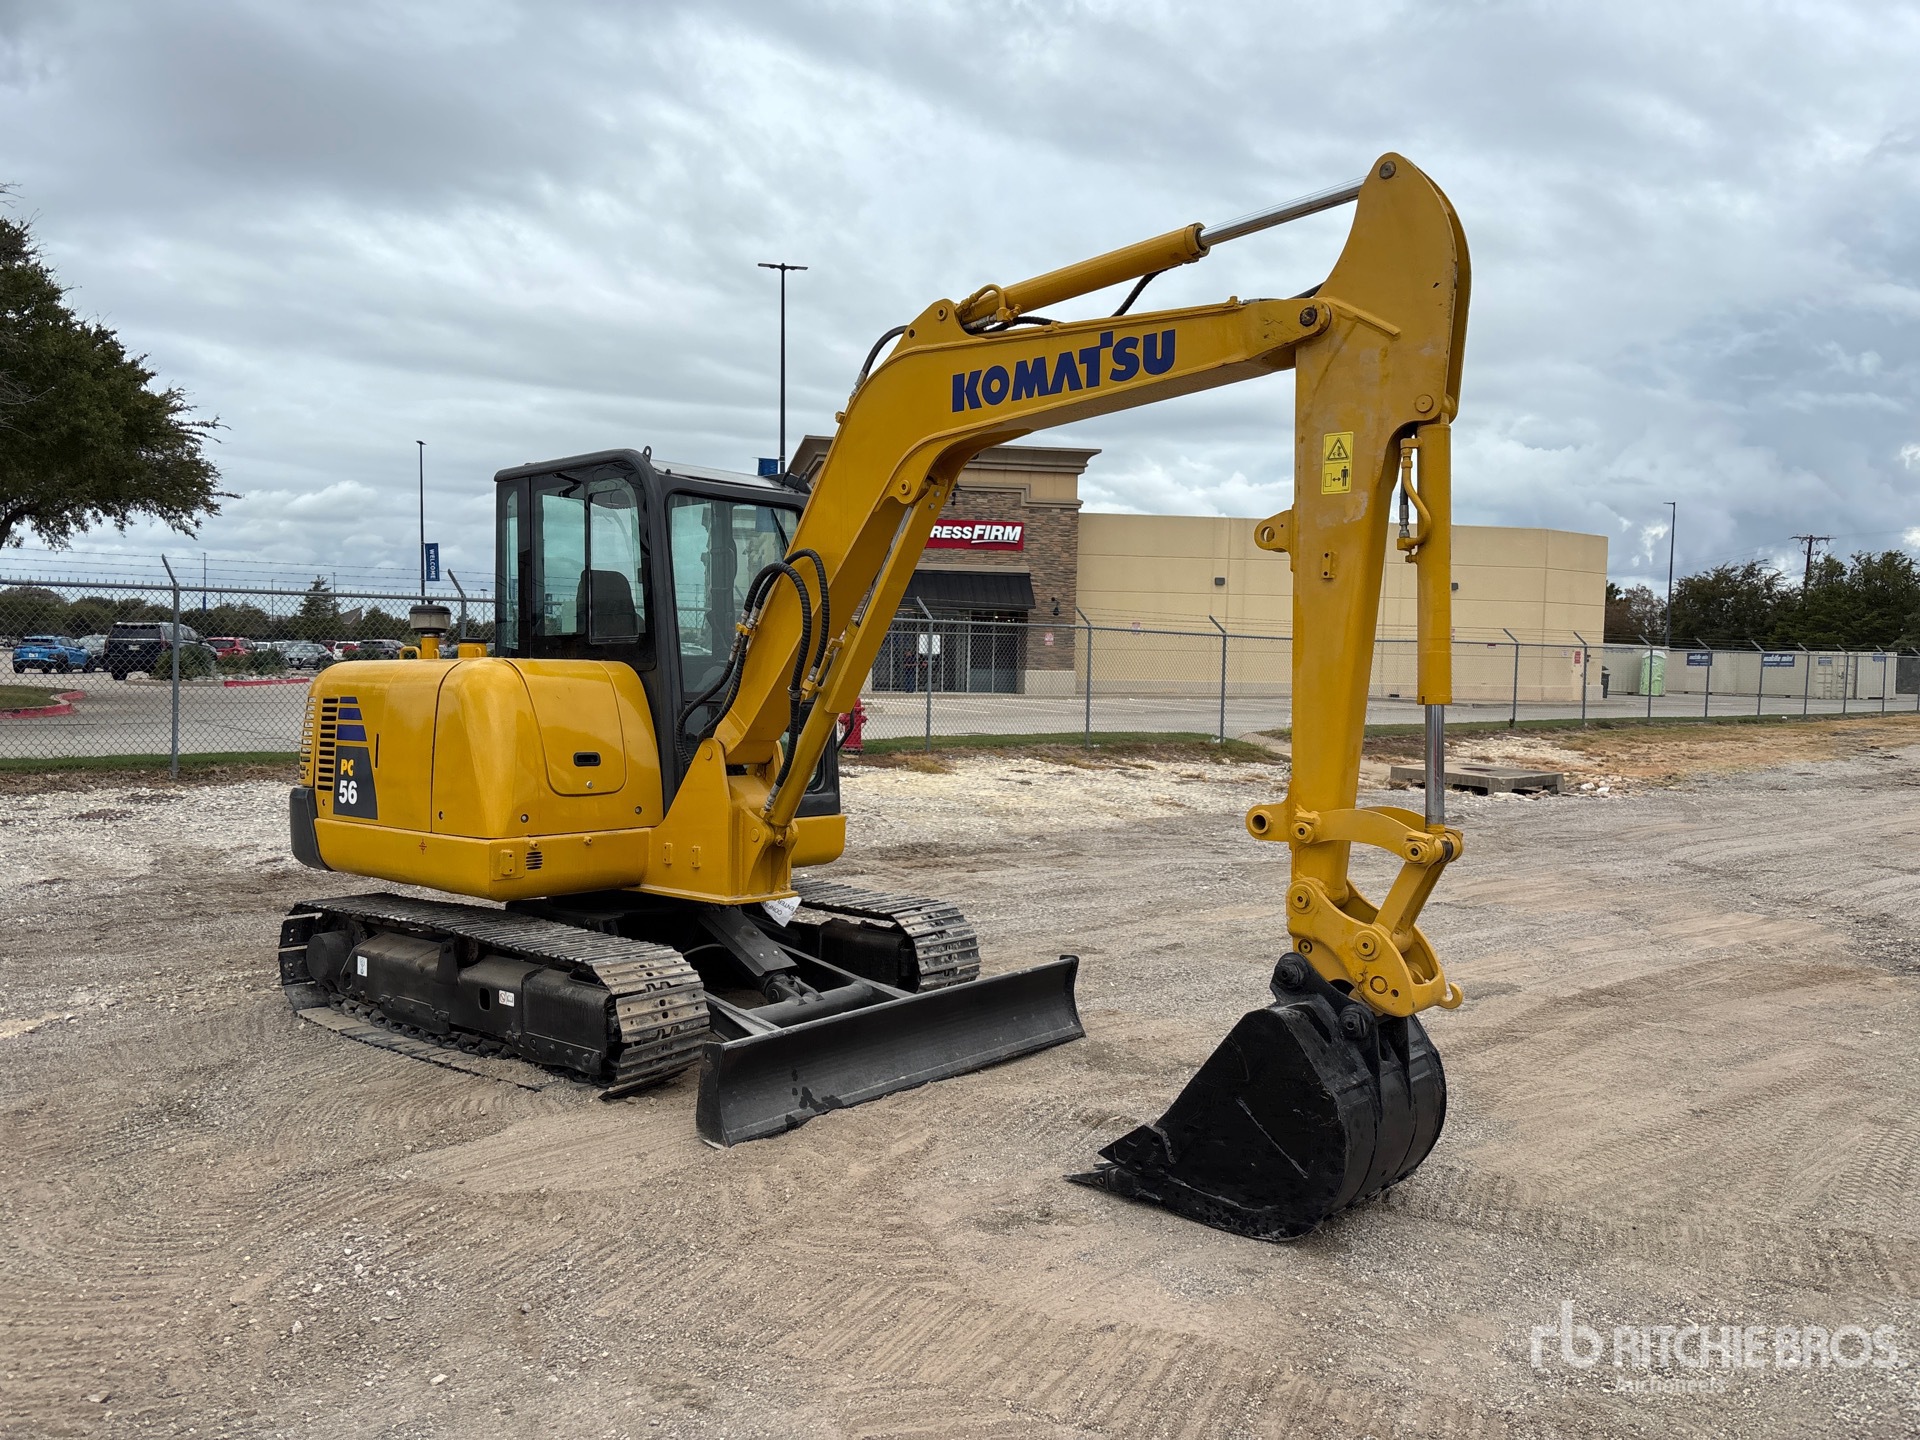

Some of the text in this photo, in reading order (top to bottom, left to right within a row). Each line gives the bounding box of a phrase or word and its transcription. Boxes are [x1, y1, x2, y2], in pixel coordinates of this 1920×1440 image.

[952, 329, 1176, 413] KOMATSU
[340, 759, 354, 776] PC
[338, 780, 358, 804] 56
